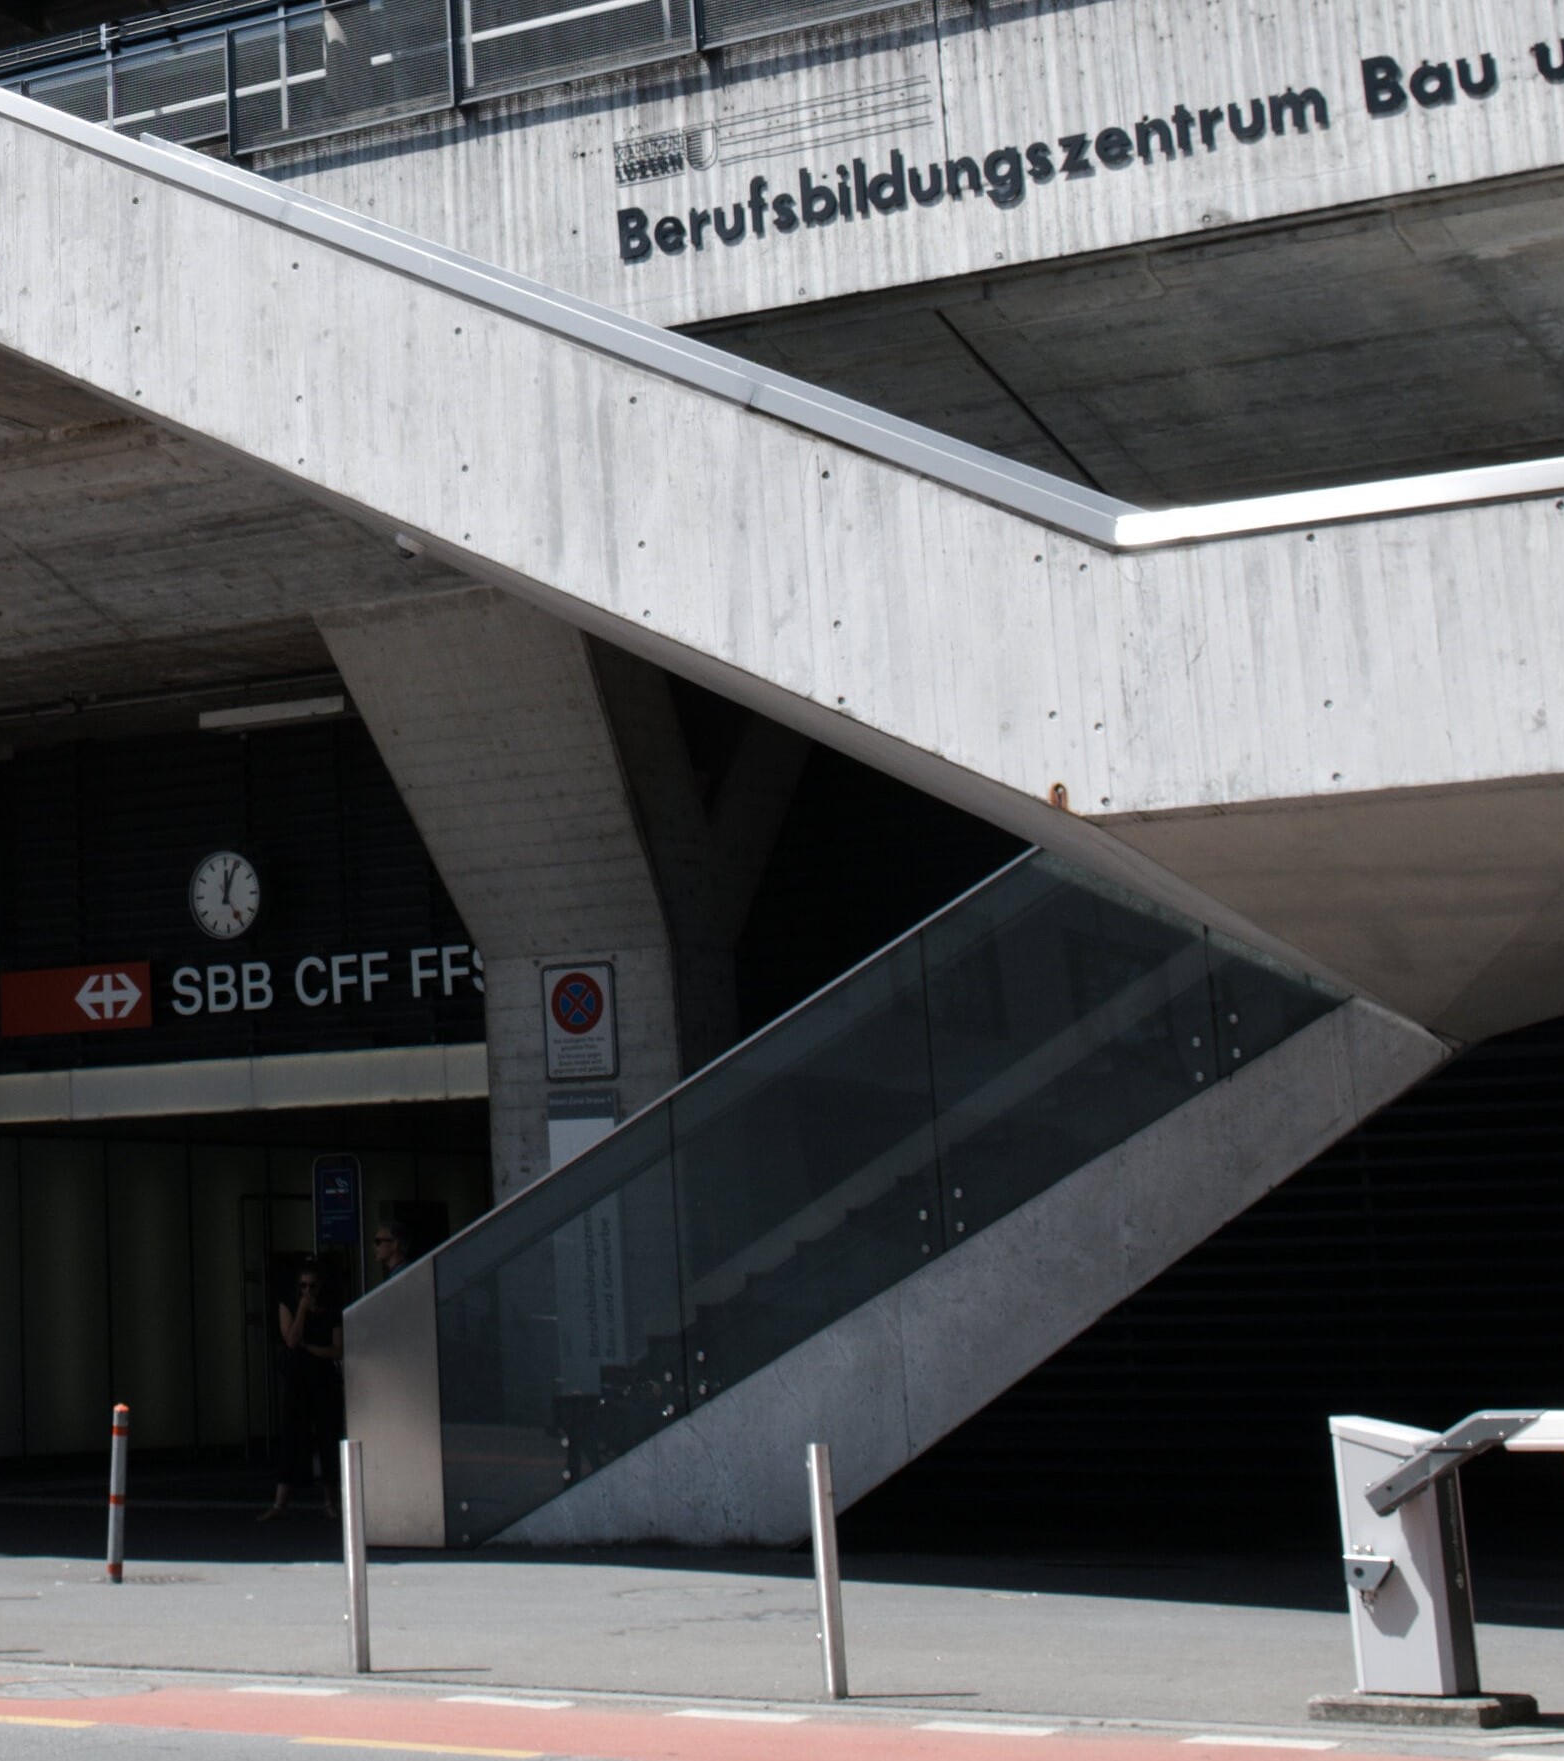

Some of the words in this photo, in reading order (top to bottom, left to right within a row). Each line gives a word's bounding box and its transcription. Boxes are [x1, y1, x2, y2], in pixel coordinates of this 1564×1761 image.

[616, 152, 684, 183] LUZERN
[618, 86, 1329, 260] Berufsbildungszentrum
[1361, 53, 1496, 117] Bau
[171, 961, 274, 1016] SBB
[294, 951, 390, 1007] CFF
